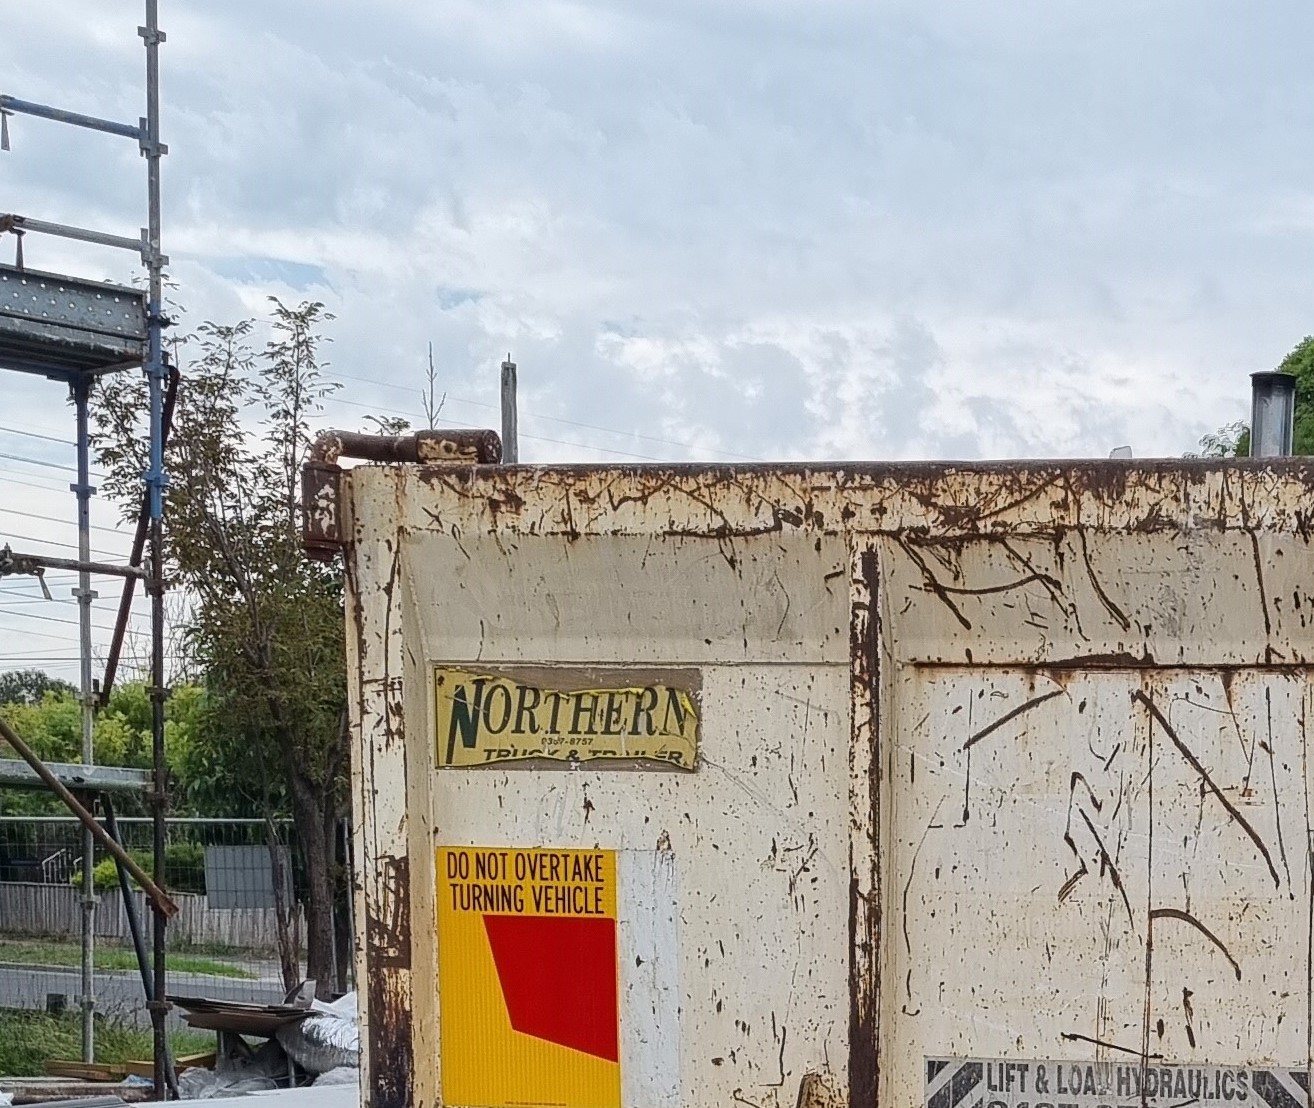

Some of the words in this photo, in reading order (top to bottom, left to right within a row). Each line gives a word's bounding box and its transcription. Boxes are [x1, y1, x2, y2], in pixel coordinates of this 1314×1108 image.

[445, 679, 687, 764] NORTHERN
[447, 852, 469, 880] DO
[475, 853, 508, 881] NOT
[514, 853, 605, 882] OVERTAKE
[449, 883, 524, 912] TURNING
[531, 886, 605, 914] VEHICLE
[987, 1062, 1029, 1093] LIFT
[1035, 1064, 1049, 1094] &
[1057, 1065, 1112, 1095] LOA
[1117, 1066, 1249, 1101] HYDRAULICS
